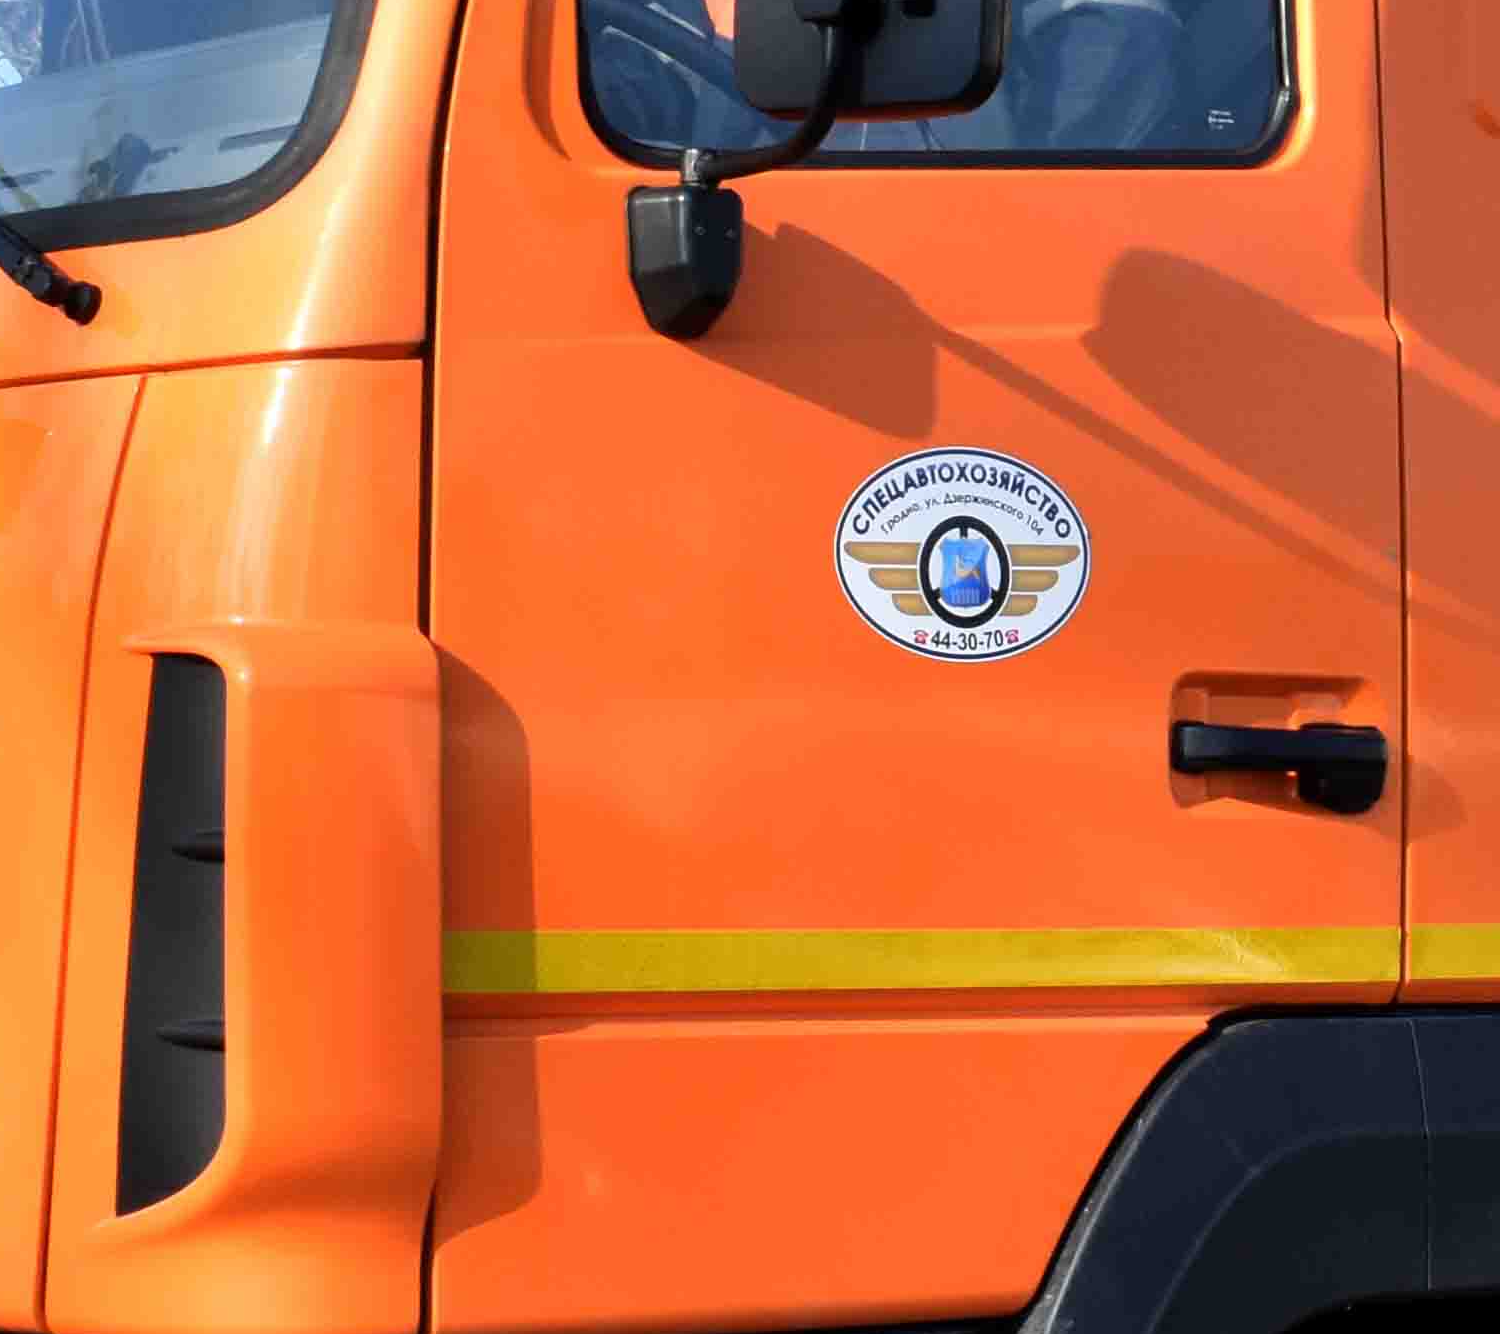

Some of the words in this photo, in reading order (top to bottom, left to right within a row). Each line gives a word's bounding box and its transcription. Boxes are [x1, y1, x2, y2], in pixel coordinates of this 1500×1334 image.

[853, 462, 1071, 539] СПЕЦАВТОХОЗЯЙСТВО
[943, 492, 1023, 520] Дзержинского
[1025, 515, 1044, 536] 104
[931, 630, 1004, 651] 44-30-70
